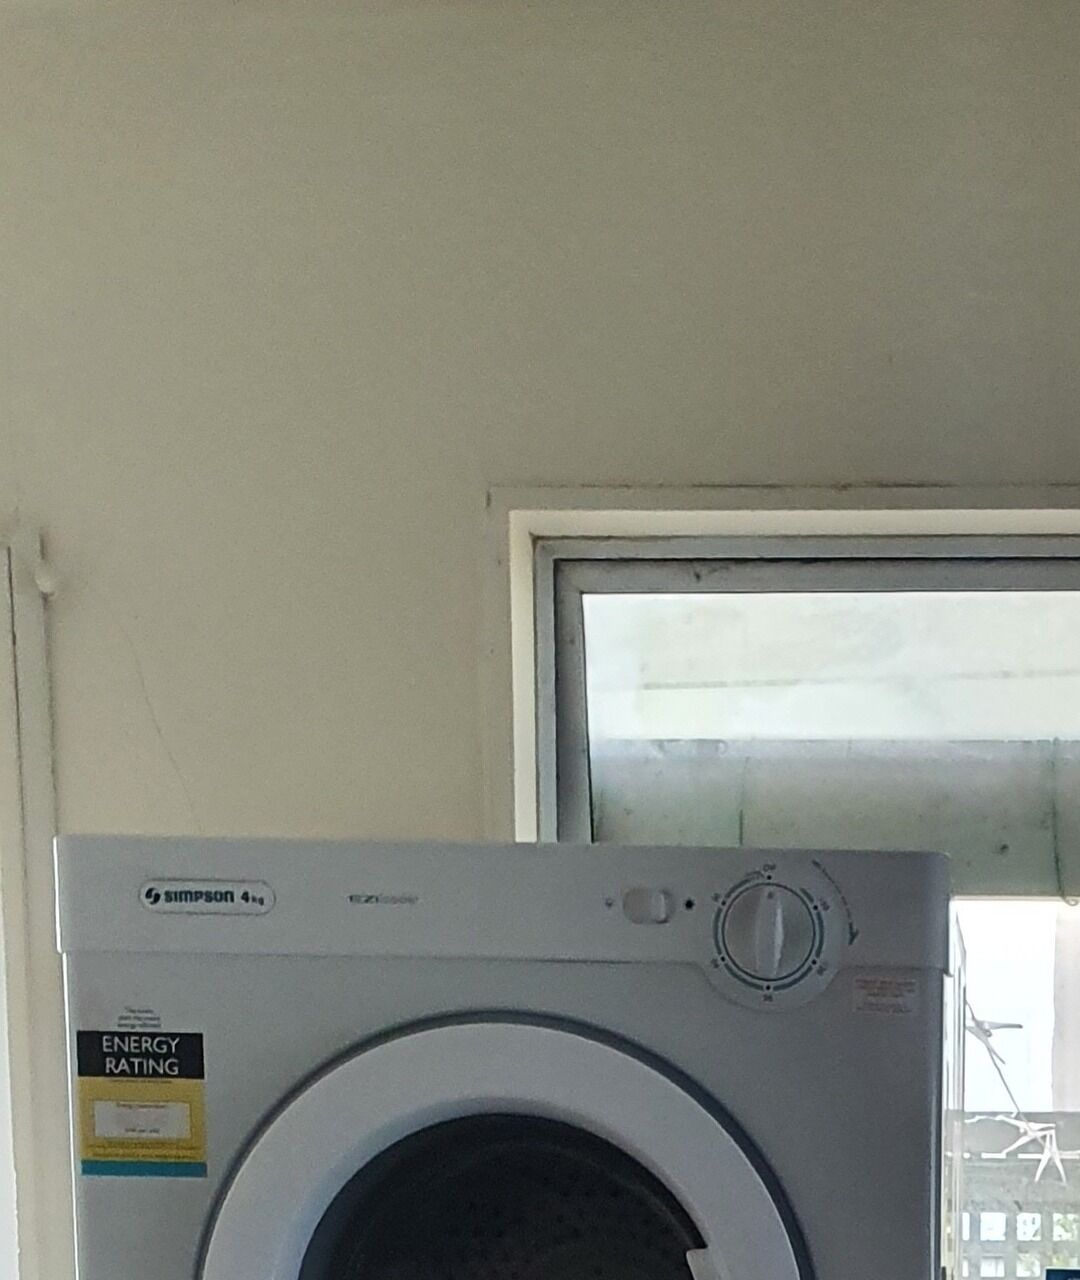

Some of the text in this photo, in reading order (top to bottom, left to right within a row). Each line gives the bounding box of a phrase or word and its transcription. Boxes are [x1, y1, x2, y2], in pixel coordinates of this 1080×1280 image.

[164, 890, 235, 903] SIMPSON
[102, 1035, 180, 1054] ENERGY
[105, 1057, 179, 1075] RATING
